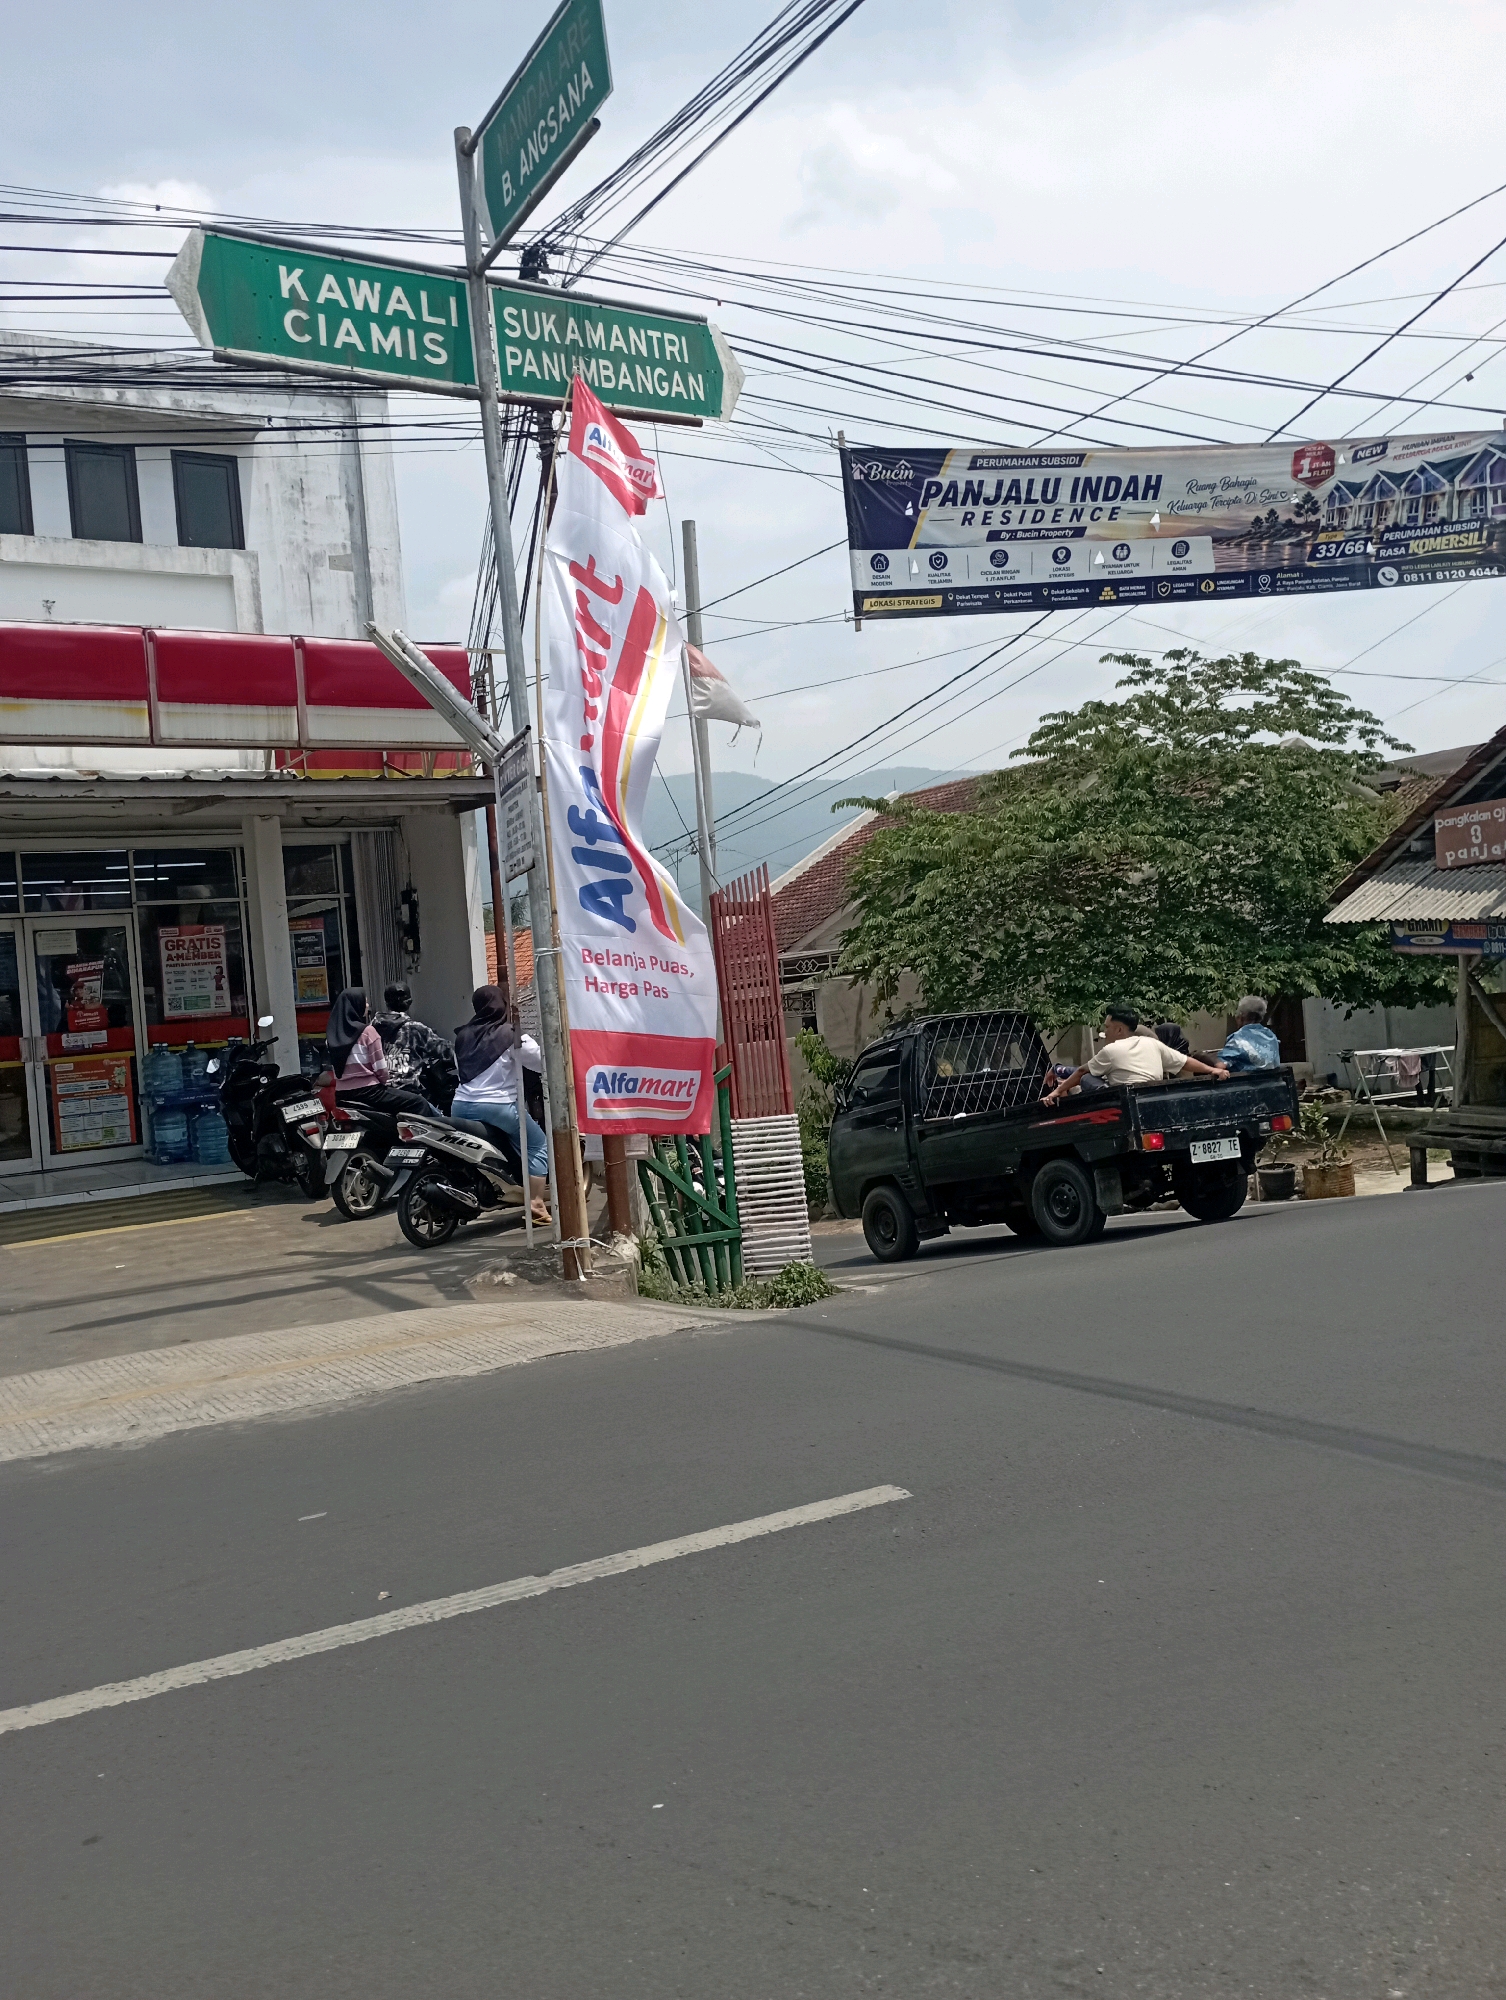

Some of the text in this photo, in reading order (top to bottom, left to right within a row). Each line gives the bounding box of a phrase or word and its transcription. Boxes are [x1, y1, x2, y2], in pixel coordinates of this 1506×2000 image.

[502, 60, 594, 207] B. ANGSANA
[278, 264, 458, 327] KAWALI
[283, 308, 449, 365] CIAMIS
[503, 306, 689, 364] SUKAMANTRI
[505, 345, 705, 401] PANUMBANGAN
[976, 456, 1080, 468] PERUMAHAN SUBSIDI
[1356, 444, 1384, 460] NEW
[864, 460, 916, 481] Bucin
[1297, 457, 1312, 479] 1
[920, 474, 1163, 508] PANJALU INDAH
[1185, 475, 1258, 495] Ruang Bahagia
[1166, 488, 1280, 515] Keluarga Tercipta Di Sini
[961, 506, 1122, 526] RESIDENCE
[1016, 530, 1039, 539] Bucin
[1040, 528, 1074, 539] Property
[1324, 533, 1338, 541] Type
[1383, 520, 1481, 542] PERUMAHAN SUBSIDI
[1315, 541, 1365, 559] 33/66
[1379, 529, 1488, 558] RASA KOMERSIL!
[1403, 566, 1500, 583] 0811 8120 4044
[869, 598, 936, 608] LOKASI STRATEGIS
[1470, 825, 1482, 844] 3
[164, 937, 222, 952] GRATIS
[581, 948, 695, 978] Belanja Puas,
[585, 976, 669, 999] Harga Pas
[592, 1071, 697, 1098] Alfamart
[1191, 1139, 1239, 1156] Z 8827 TE
